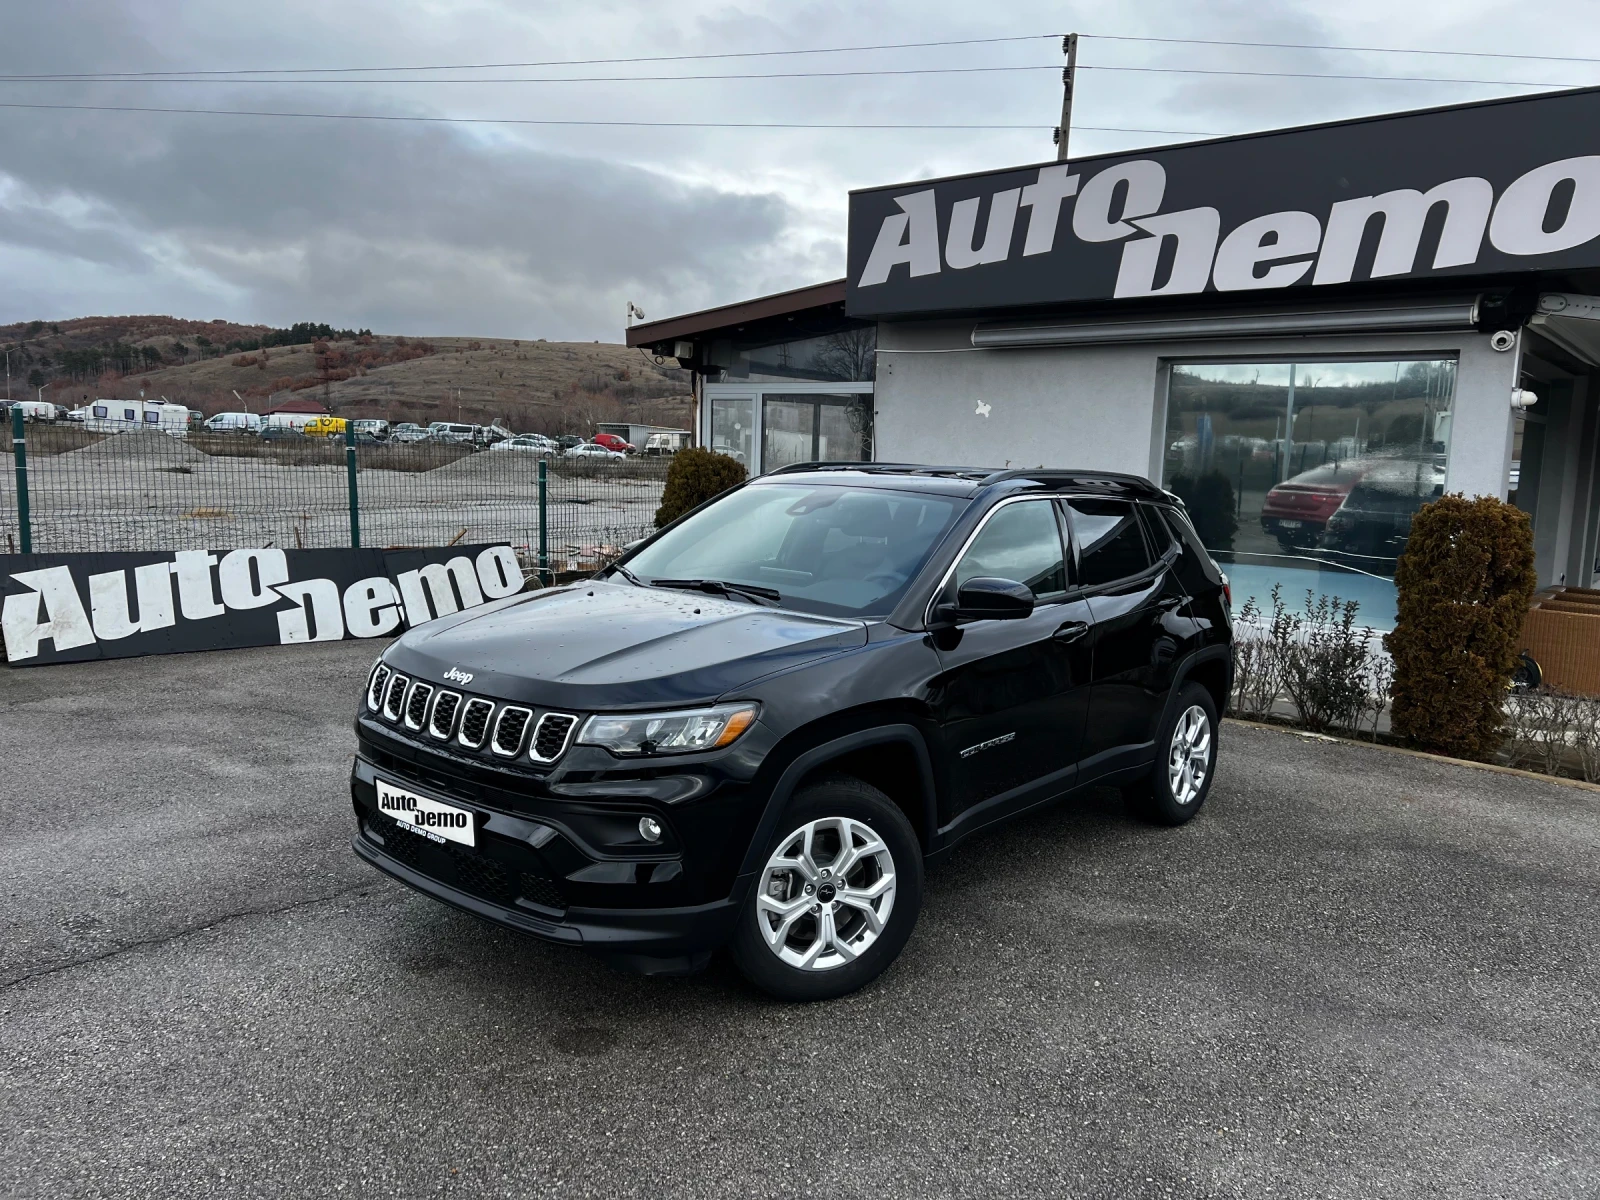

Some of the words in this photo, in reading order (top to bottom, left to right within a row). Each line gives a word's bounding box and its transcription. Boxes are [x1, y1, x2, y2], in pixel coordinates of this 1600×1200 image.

[857, 158, 1167, 288] Auto
[1112, 154, 1600, 300] Demo
[1, 548, 290, 662] Auto
[270, 545, 525, 645] Demo
[443, 666, 474, 686] Jeep
[381, 792, 418, 812] Auto
[396, 819, 410, 831] AUTO
[410, 825, 427, 837] DEMO
[427, 831, 446, 844] GROUP
[414, 808, 468, 829] Demo
